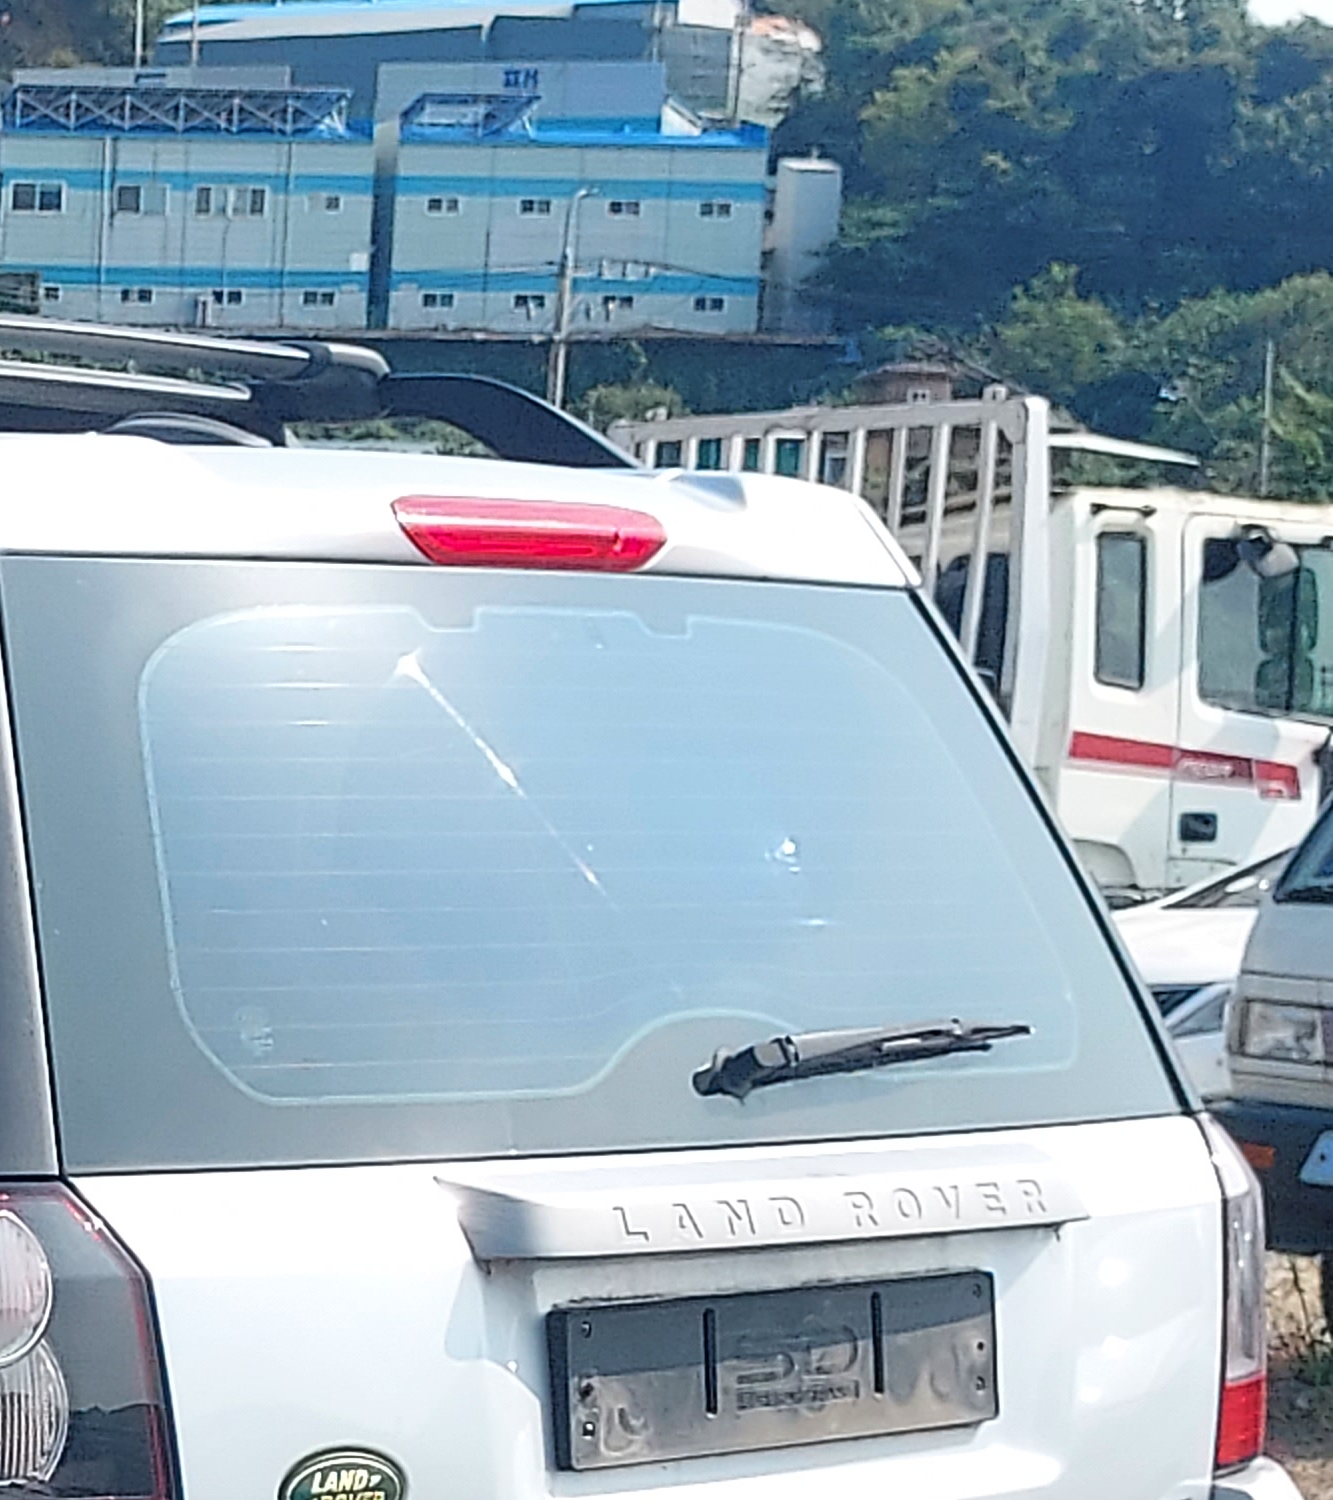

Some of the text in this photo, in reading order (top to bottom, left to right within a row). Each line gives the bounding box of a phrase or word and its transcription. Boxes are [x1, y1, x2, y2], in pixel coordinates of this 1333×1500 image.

[611, 1178, 1049, 1244] LAND ROVER
[311, 1469, 369, 1494] LAND
